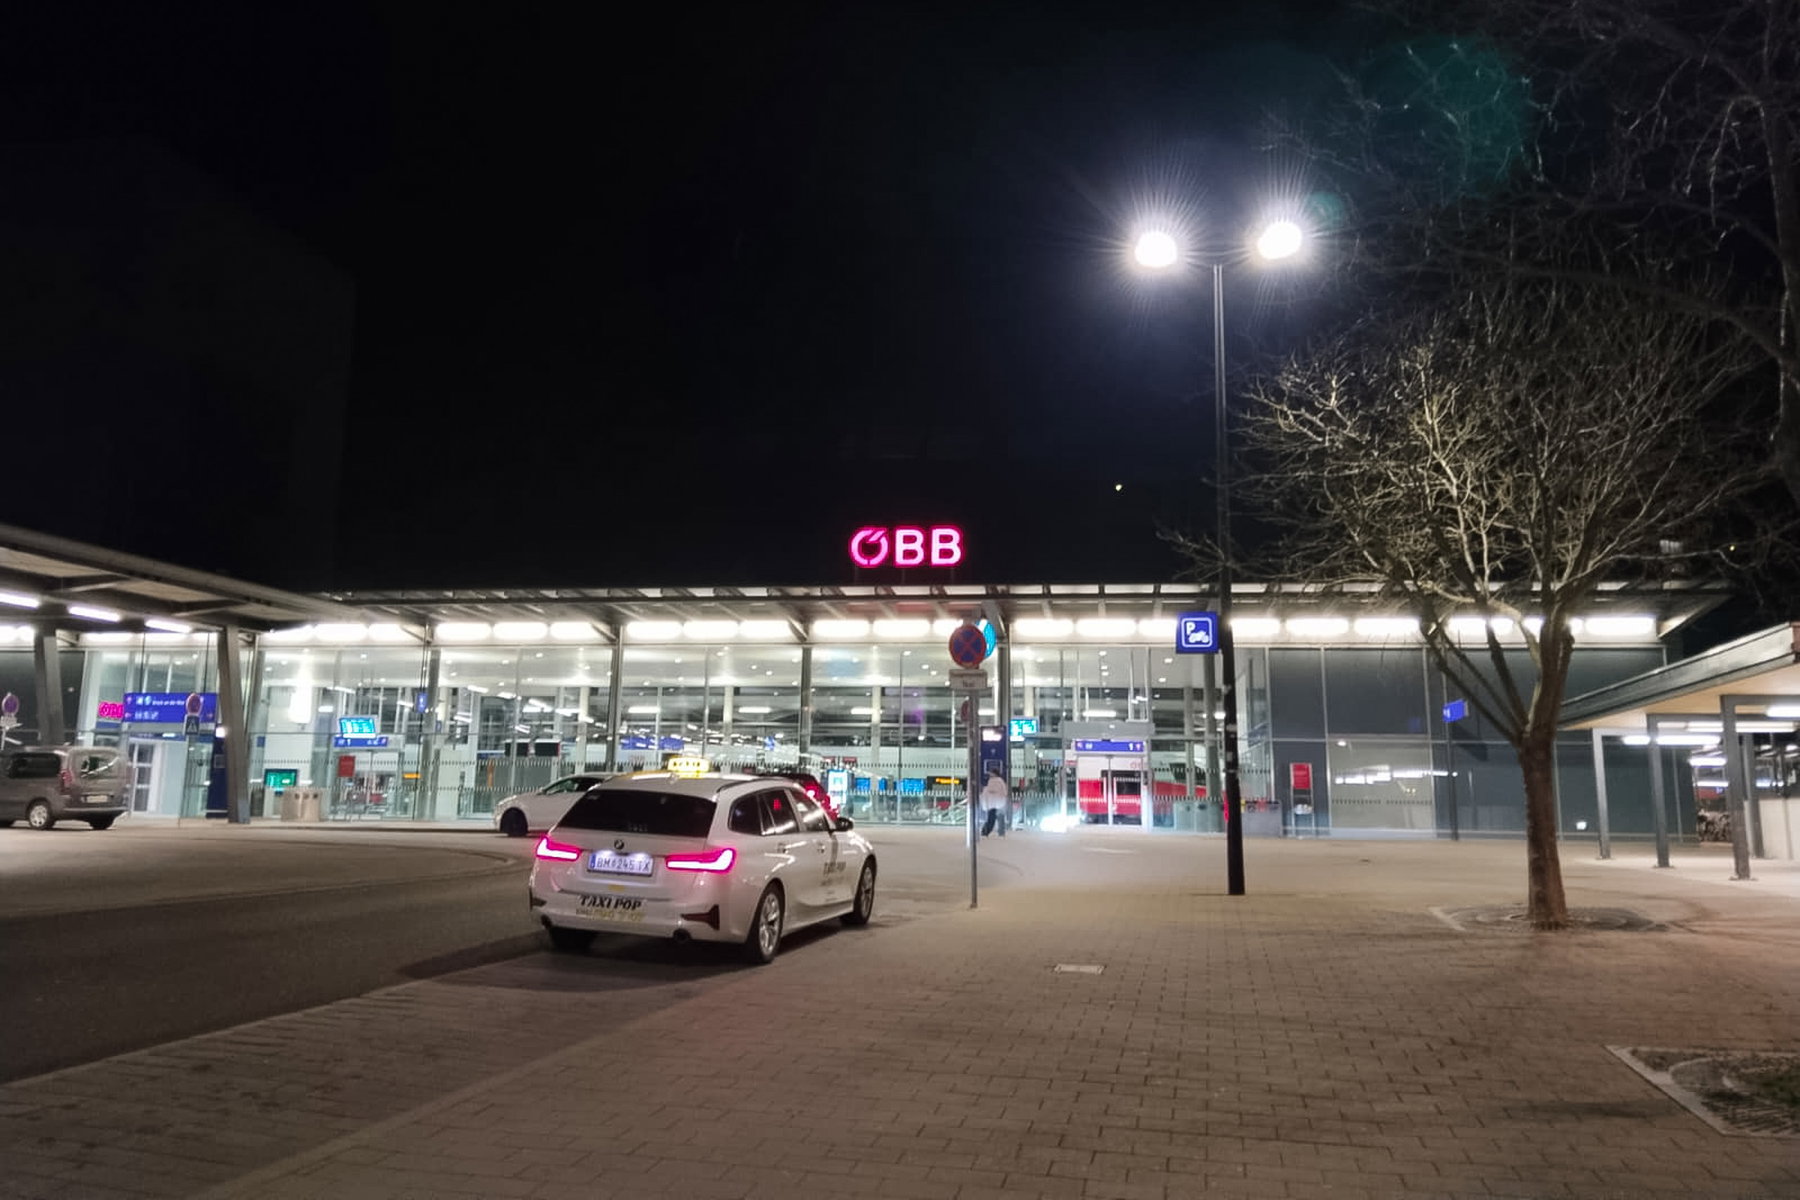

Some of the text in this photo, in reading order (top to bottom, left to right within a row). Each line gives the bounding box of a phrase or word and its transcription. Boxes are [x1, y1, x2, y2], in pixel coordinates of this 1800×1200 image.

[849, 526, 963, 567] ÖBB
[1186, 621, 1196, 636] P
[581, 894, 641, 910] TAXI POP
